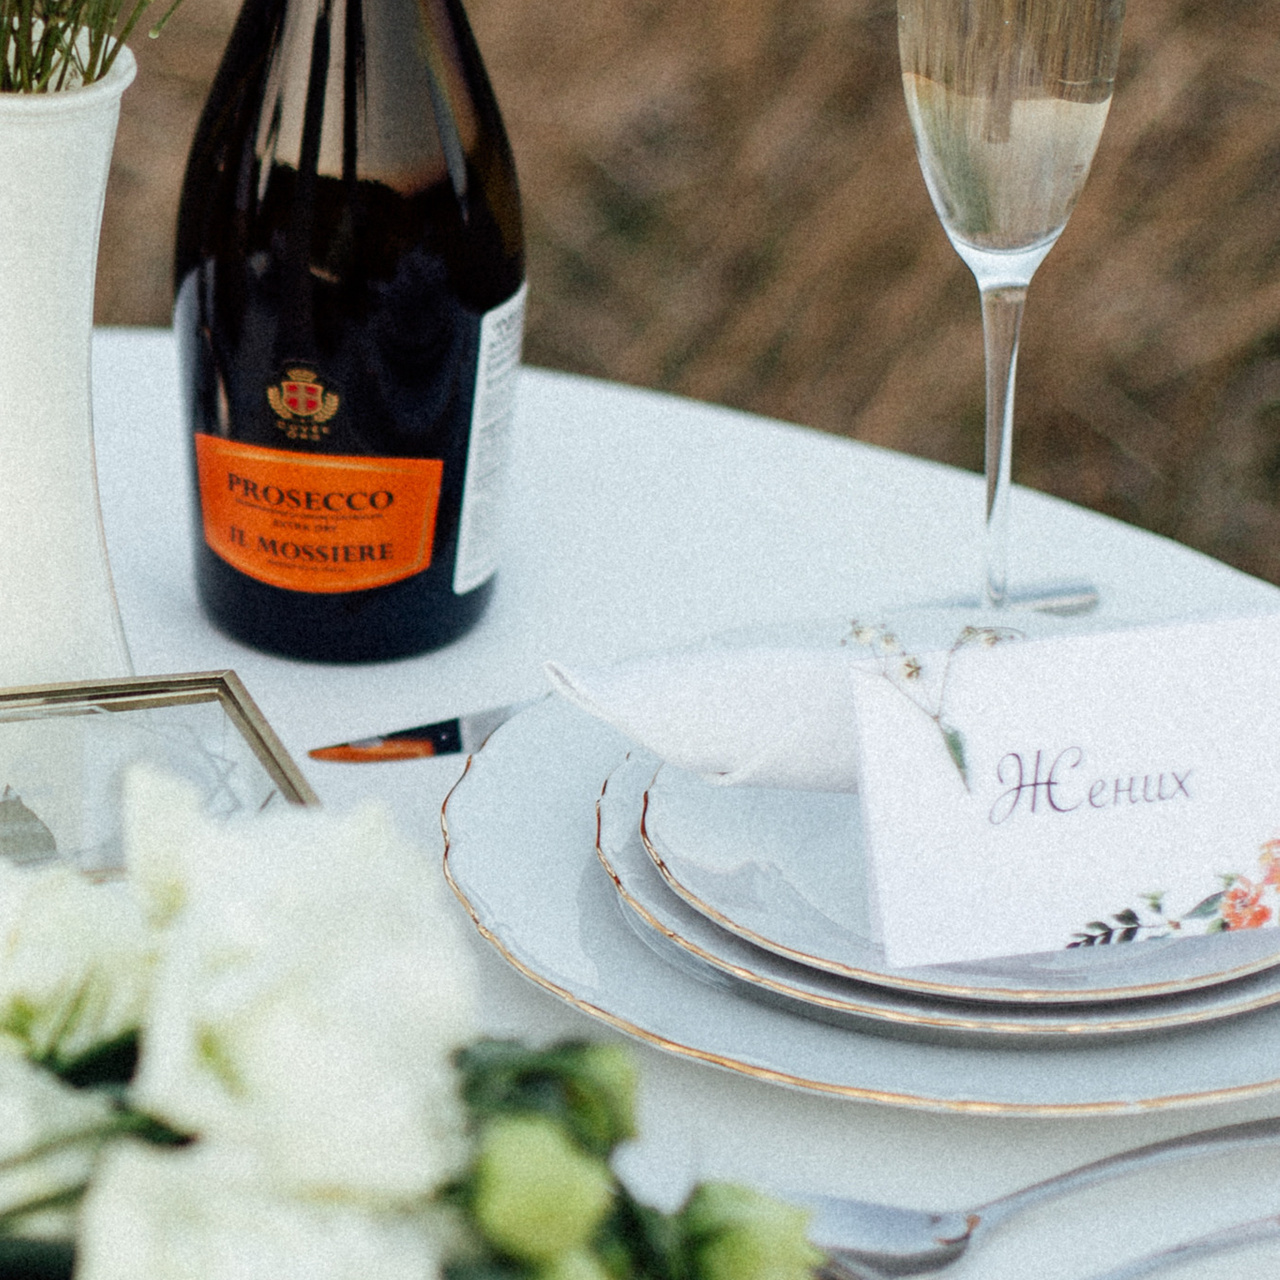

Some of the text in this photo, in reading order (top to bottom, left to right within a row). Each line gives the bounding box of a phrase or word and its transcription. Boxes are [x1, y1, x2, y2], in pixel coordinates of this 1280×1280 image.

[228, 472, 394, 512] PROSECCO
[229, 524, 394, 563] IL MOSSIERE
[988, 746, 1193, 825] Жених
